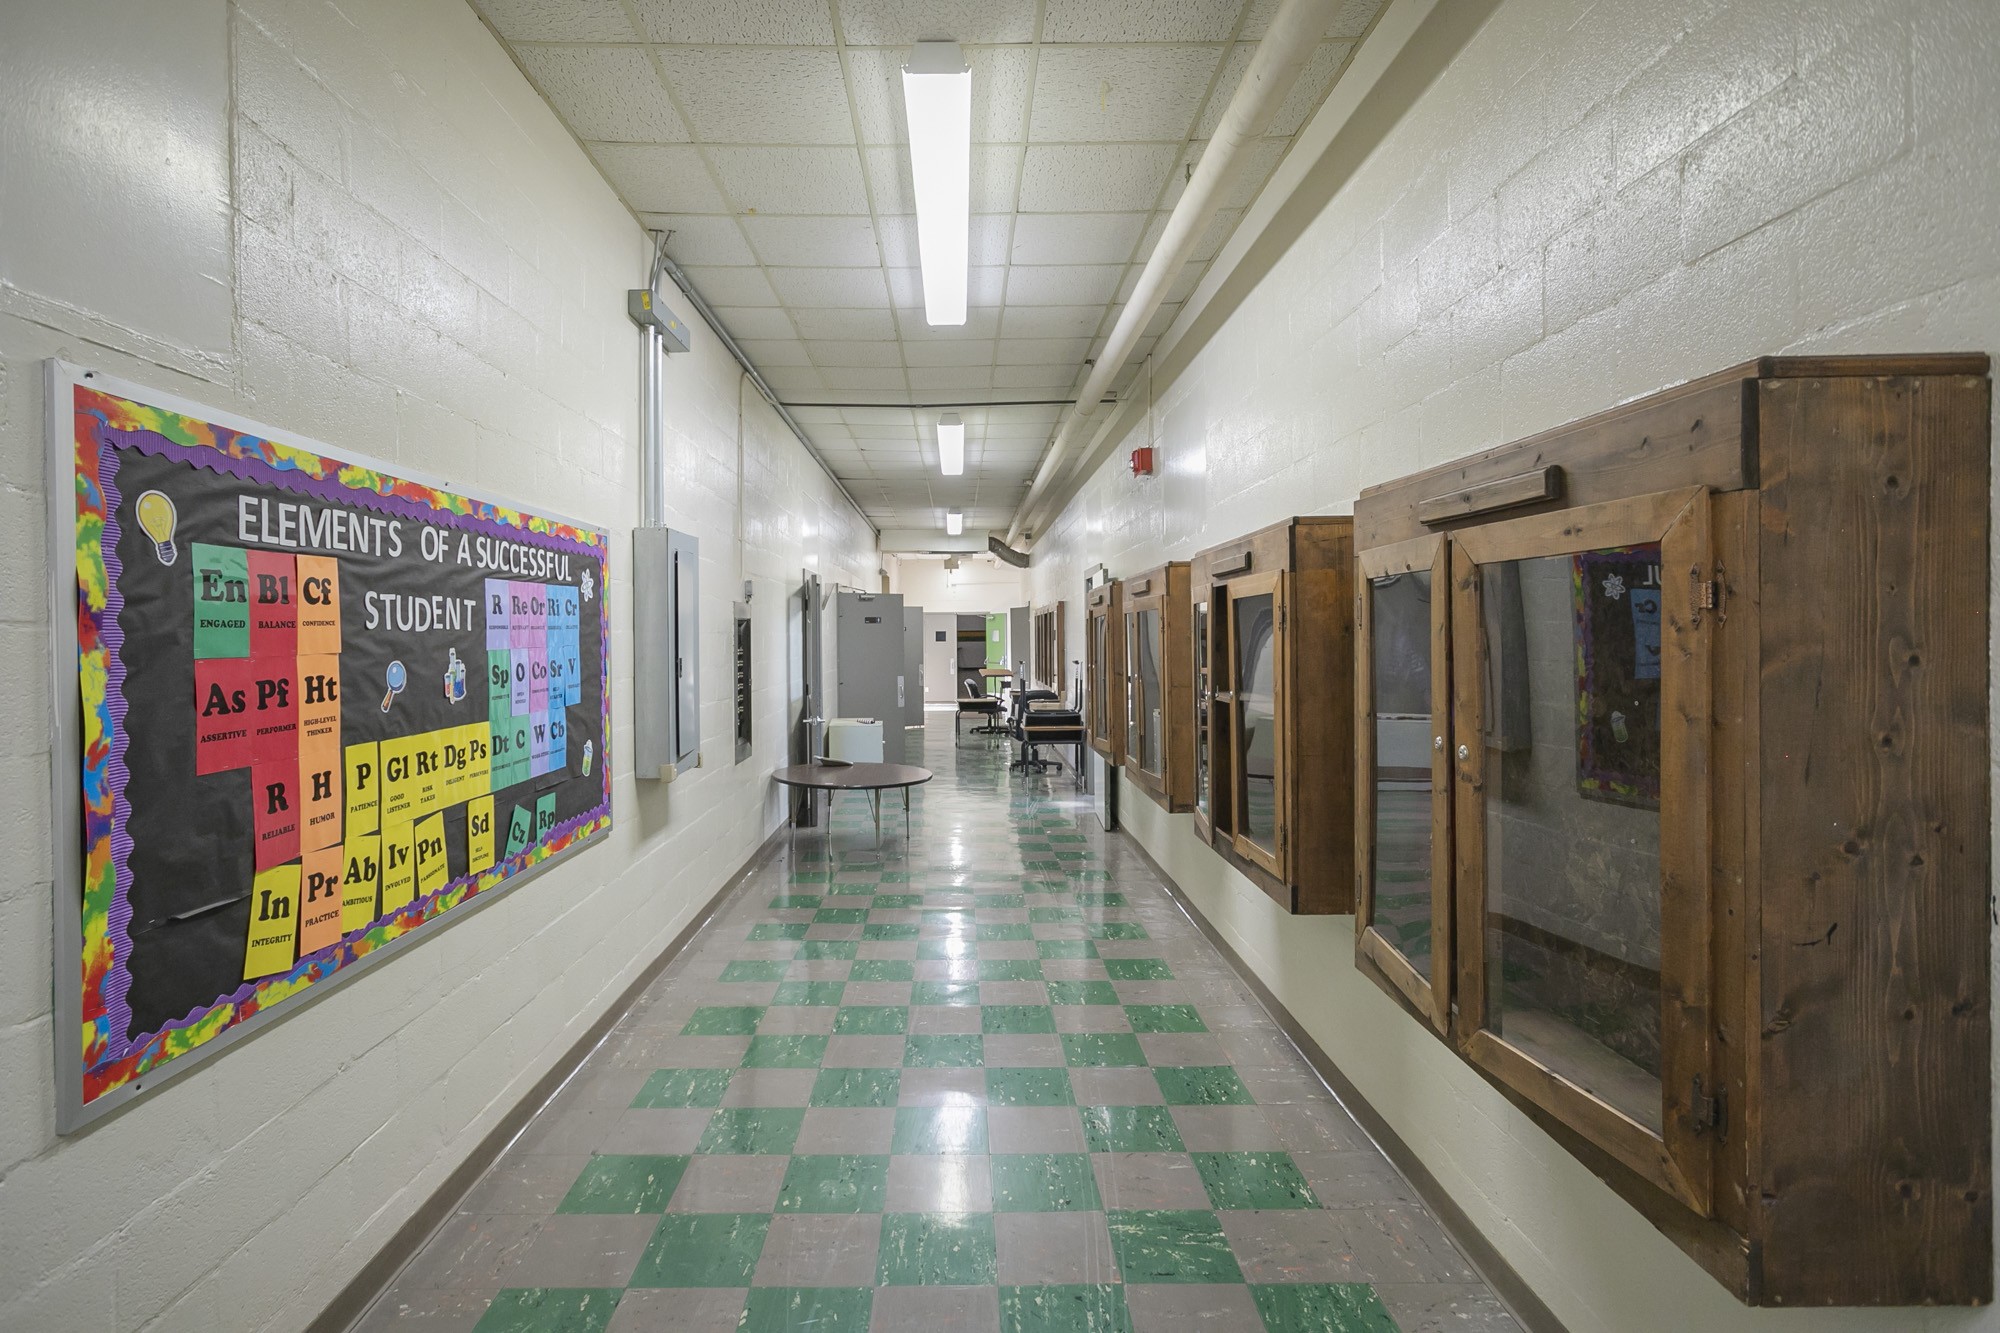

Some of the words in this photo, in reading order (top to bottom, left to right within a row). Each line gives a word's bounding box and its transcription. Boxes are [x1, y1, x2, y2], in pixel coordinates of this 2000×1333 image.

[238, 494, 402, 558] ELEMENTS
[420, 526, 449, 563] OF
[457, 534, 472, 567] A
[476, 536, 572, 581] SUCCESSFUL
[200, 569, 247, 603] En
[257, 574, 290, 604] Bl
[303, 577, 332, 605] Cf
[365, 591, 476, 632] STUDENT
[492, 595, 503, 615] R
[512, 596, 528, 615] Re
[530, 596, 545, 616] Or
[547, 598, 560, 616] Ri
[565, 599, 577, 616] Cr
[200, 619, 246, 629] ENGAGED
[258, 621, 296, 629] BALANCE
[516, 662, 525, 682] O
[532, 661, 547, 680] Co
[550, 659, 563, 678] Sr
[568, 658, 576, 675] V
[492, 665, 509, 689] Sp
[255, 678, 290, 710] Pf
[305, 675, 337, 704] Ht
[202, 683, 246, 717] As
[256, 724, 296, 736] PERFORMER
[303, 716, 337, 726] HIGH-LEVEL
[550, 721, 565, 740] Cb
[200, 730, 247, 743] ASSERTIVE
[307, 727, 333, 737] THINKER
[516, 730, 525, 749] C
[534, 724, 546, 744] W
[469, 740, 487, 761] Ps
[492, 735, 509, 756] Dt
[416, 751, 438, 776] Rt
[444, 744, 466, 770] Dg
[356, 763, 371, 790] P
[387, 755, 409, 782] Gl
[311, 771, 332, 801] H
[266, 782, 289, 814] R
[350, 800, 378, 813] PATIENCE
[390, 793, 405, 802] GOOD
[387, 802, 411, 814] LISTENER
[309, 812, 335, 826] HUMOR
[471, 812, 490, 837] Sd
[539, 810, 555, 830] Rp
[262, 824, 295, 841] RELIABLE
[512, 821, 526, 844] Cz
[388, 844, 410, 870] Iv
[417, 837, 443, 866] Pn
[343, 857, 376, 885] Ab
[307, 872, 338, 902] Pr
[384, 876, 412, 891] INVOLVED
[258, 890, 290, 921] In
[342, 895, 373, 907] AMBITIOUS
[305, 910, 339, 927] PRACTICE
[251, 934, 292, 947] INTEGRITY
